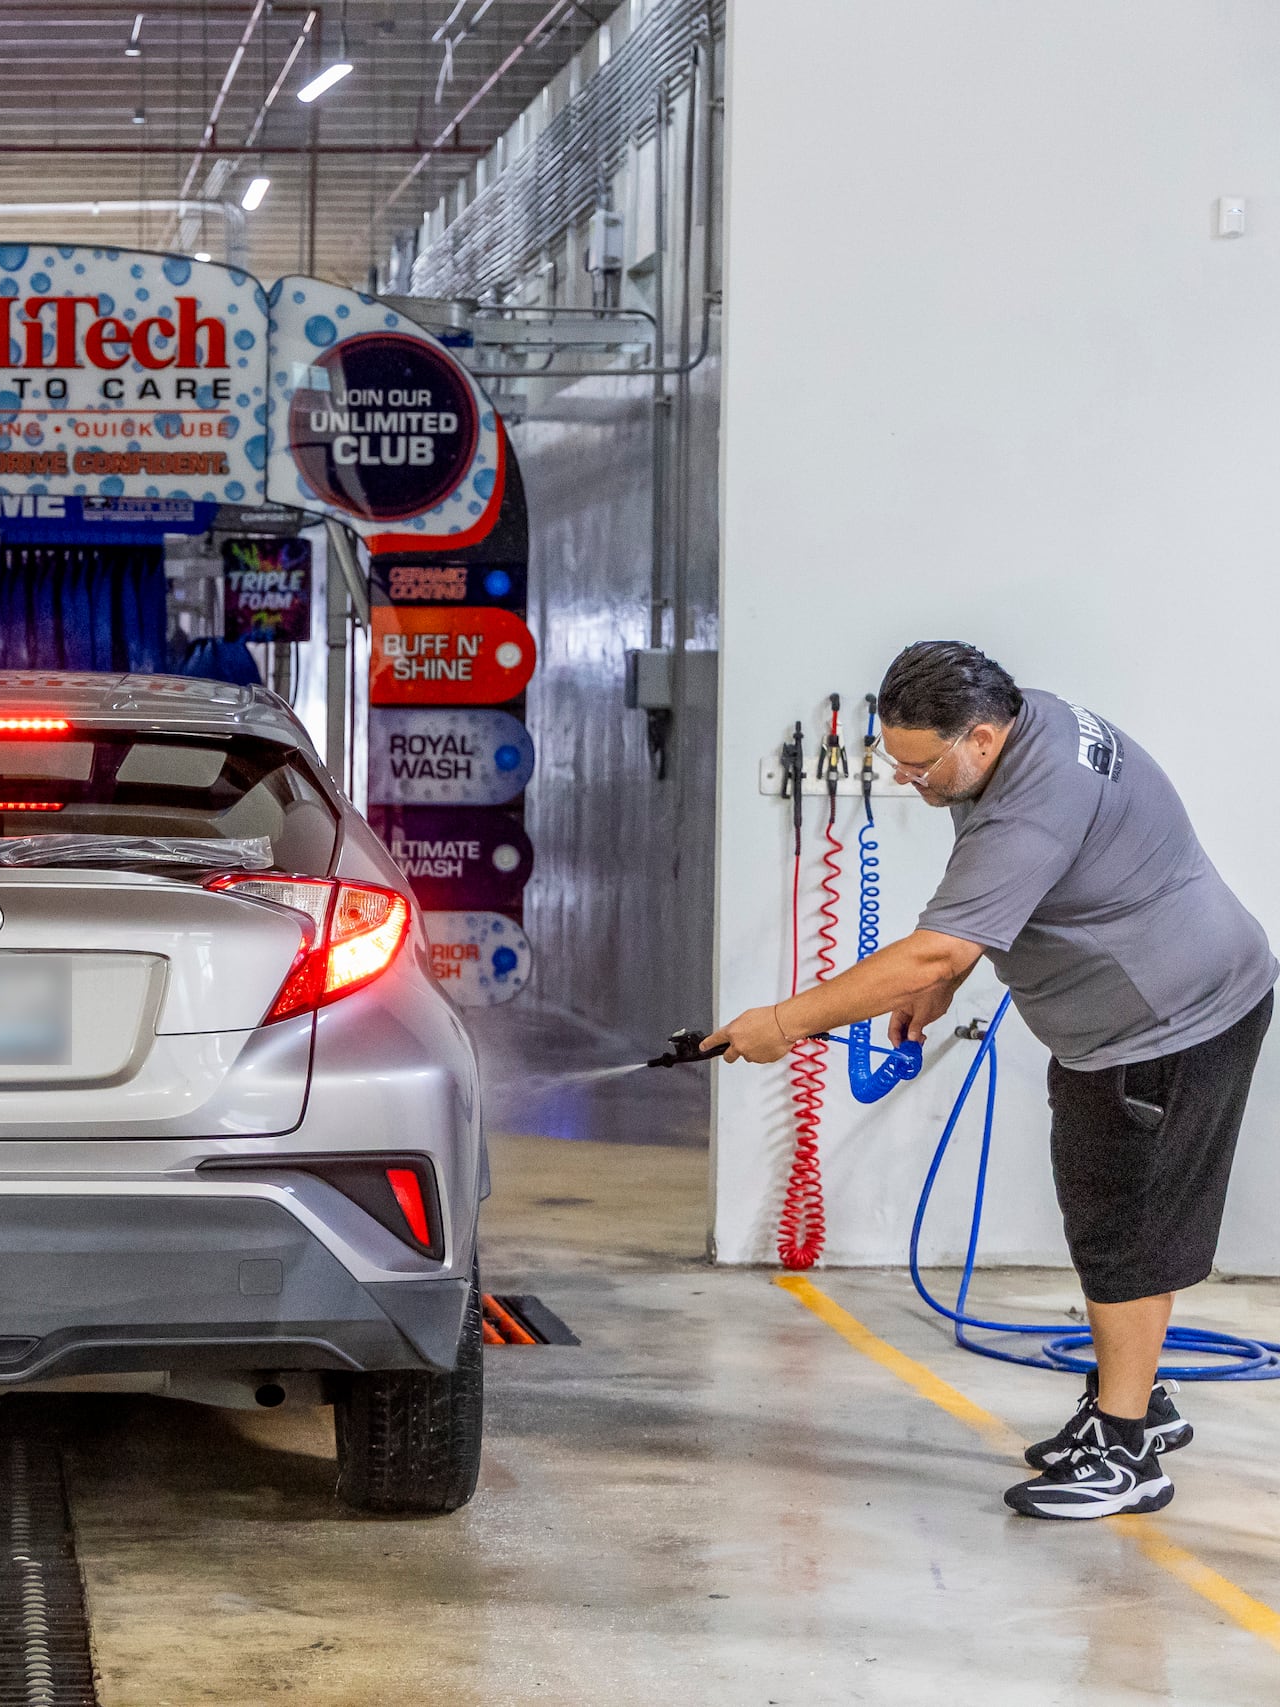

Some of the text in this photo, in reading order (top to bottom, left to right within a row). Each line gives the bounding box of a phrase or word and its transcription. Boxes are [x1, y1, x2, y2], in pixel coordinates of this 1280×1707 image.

[102, 378, 231, 400] CARE
[336, 389, 432, 407] JOIN OUR
[74, 421, 153, 438] QUICK
[165, 421, 230, 438] LUBE
[310, 411, 458, 433] UNLIMITED
[332, 435, 435, 466] CLUB
[74, 452, 231, 475] CONFIDENT.
[228, 570, 305, 592] TRIPLE
[238, 592, 294, 610] FOAM
[383, 633, 450, 657] BUFF
[393, 658, 473, 681] SHINE
[389, 734, 474, 756] ROYAL
[390, 758, 472, 780] WASH
[400, 860, 463, 879] WASH
